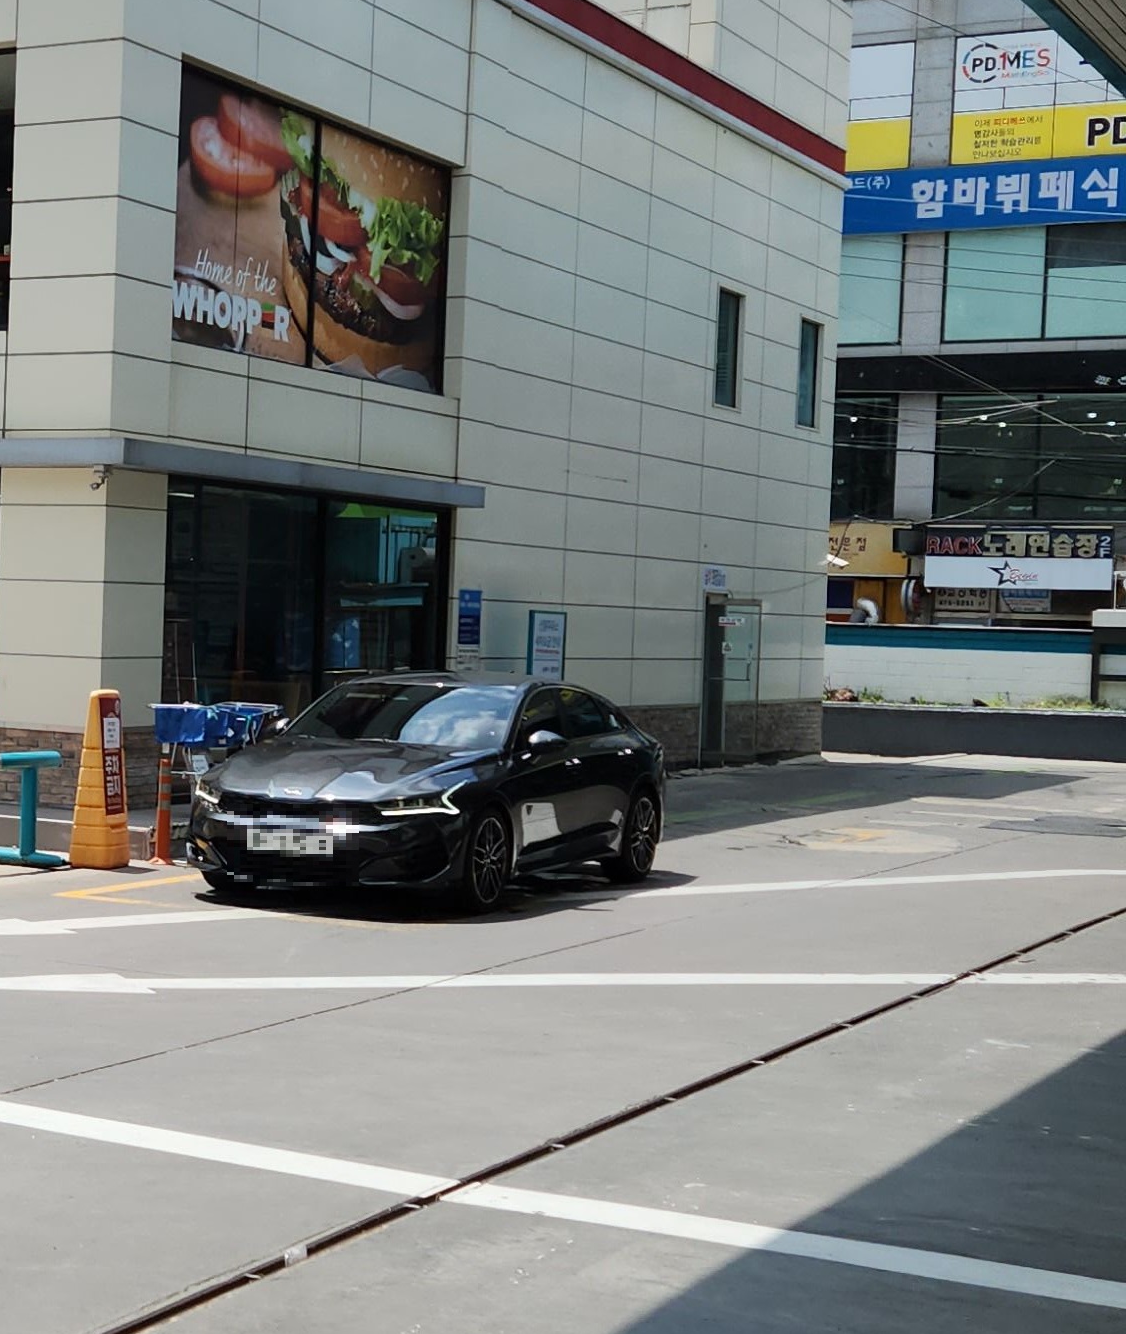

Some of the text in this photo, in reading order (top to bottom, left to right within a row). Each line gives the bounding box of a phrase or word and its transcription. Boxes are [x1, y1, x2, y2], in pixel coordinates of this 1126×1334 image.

[911, 167, 1120, 219] 함바뷔페식
[194, 248, 277, 297] Home of the
[926, 536, 983, 555] RACK
